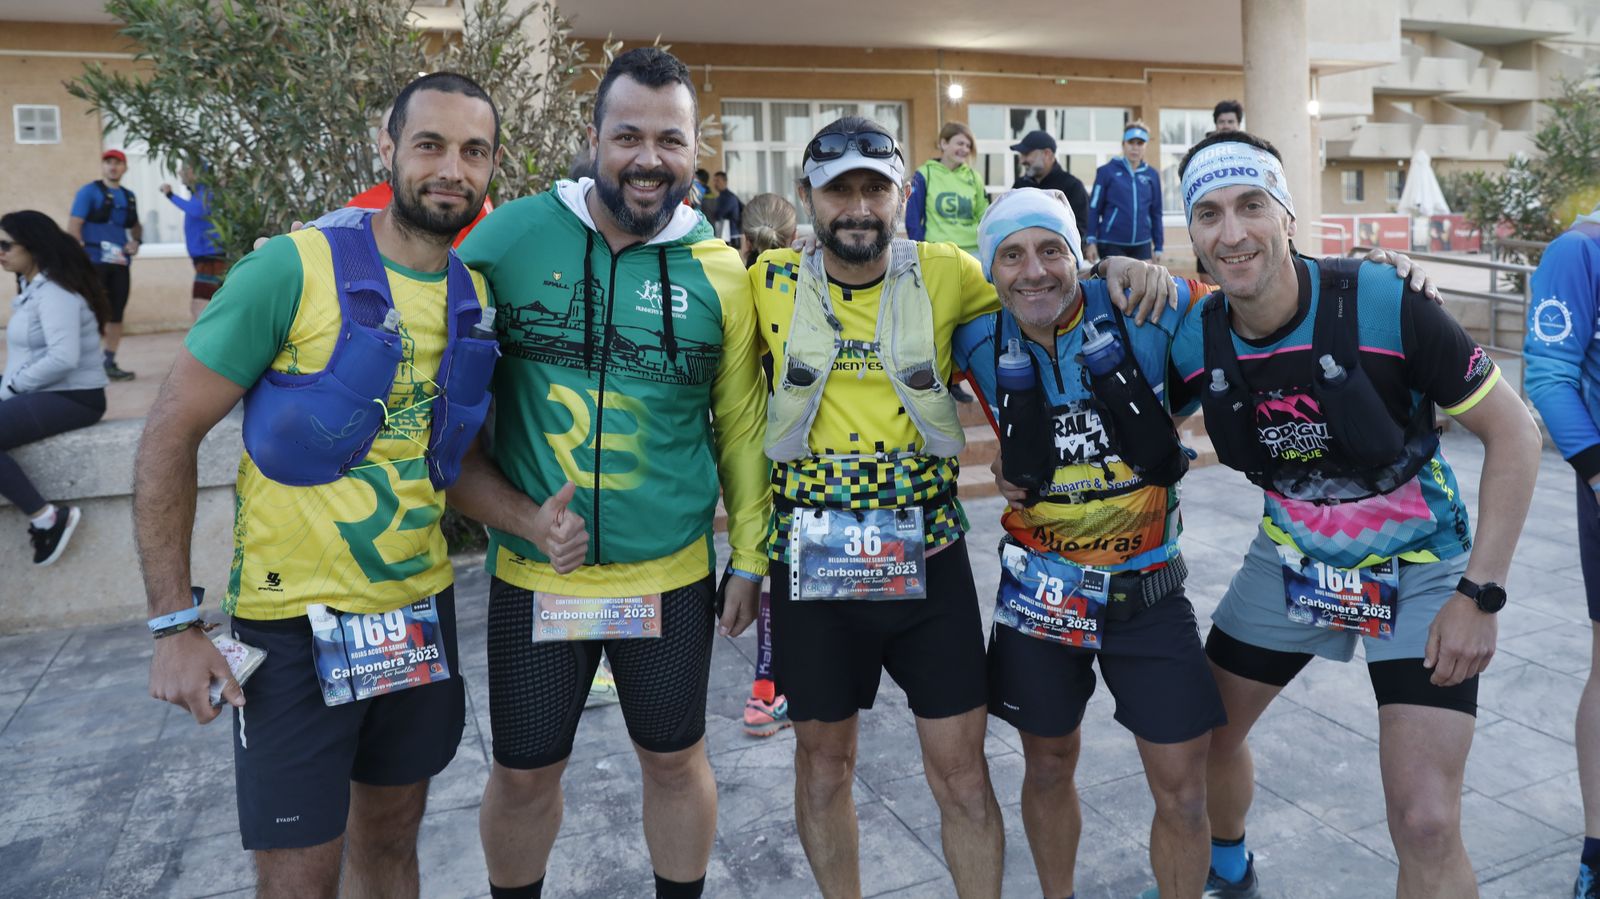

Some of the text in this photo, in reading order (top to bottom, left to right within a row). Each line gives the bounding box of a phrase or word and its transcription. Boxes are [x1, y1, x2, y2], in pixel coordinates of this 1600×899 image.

[1185, 166, 1259, 206] NINGUNO
[1094, 477, 1103, 490] &
[844, 525, 882, 556] 36
[817, 565, 918, 577] Carbonera 2023
[1314, 562, 1363, 594] 164
[1034, 571, 1064, 606] 73
[540, 607, 656, 620] Carbonerilla 2023
[1009, 599, 1064, 626] Carbonera
[1067, 618, 1098, 632] 2023
[1299, 595, 1359, 615] Carbonera
[1362, 606, 1392, 619] 2023
[346, 608, 408, 650] 169
[759, 607, 773, 675] Kalenji
[331, 648, 440, 680] Carbonera 2023
[367, 645, 389, 658] ACOSTA
[275, 815, 300, 823] EVADICT
